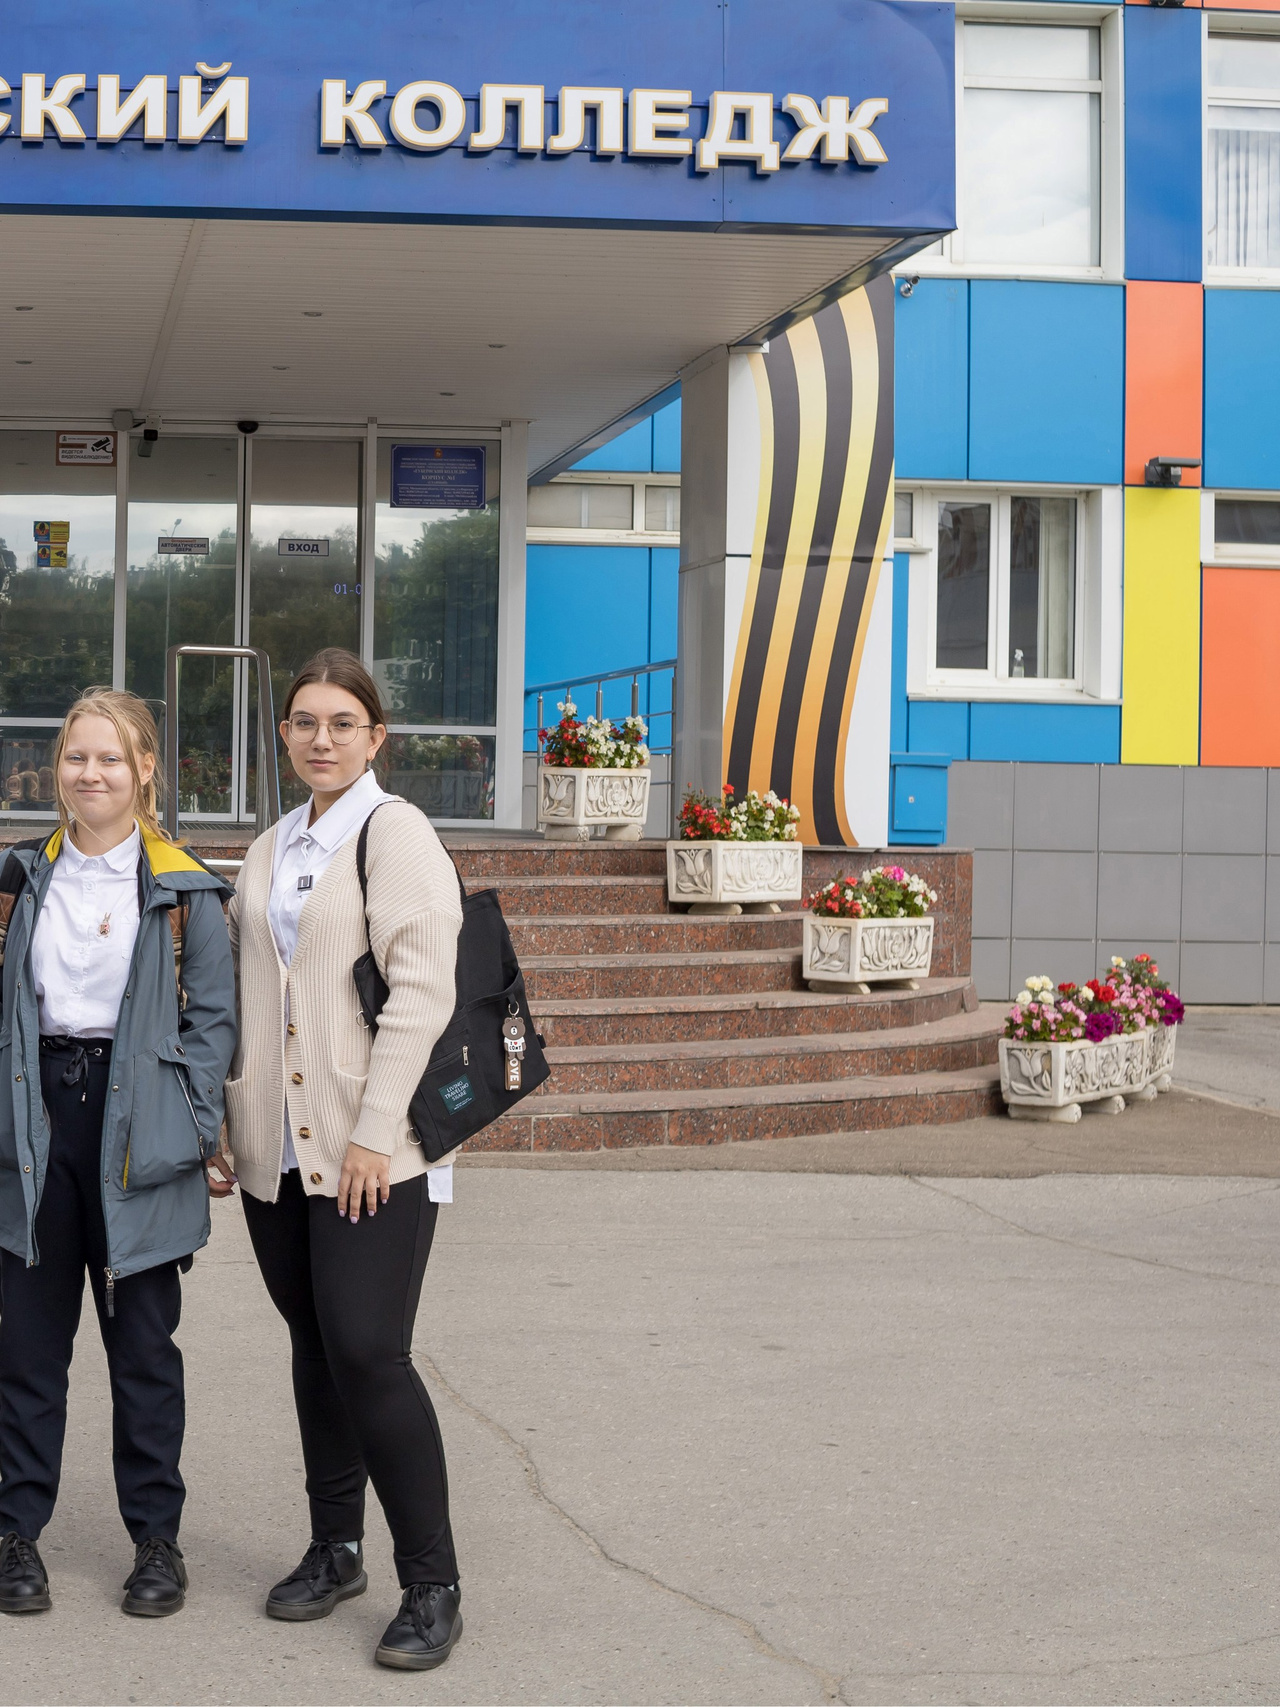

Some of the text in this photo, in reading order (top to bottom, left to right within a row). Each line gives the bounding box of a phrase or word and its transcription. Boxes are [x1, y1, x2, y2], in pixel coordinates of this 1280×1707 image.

[321, 78, 888, 174] КОЛЛЕДЖ
[288, 544, 319, 553] ВХОД
[510, 1058, 519, 1081] OVE
[447, 1081, 463, 1092] LIVING
